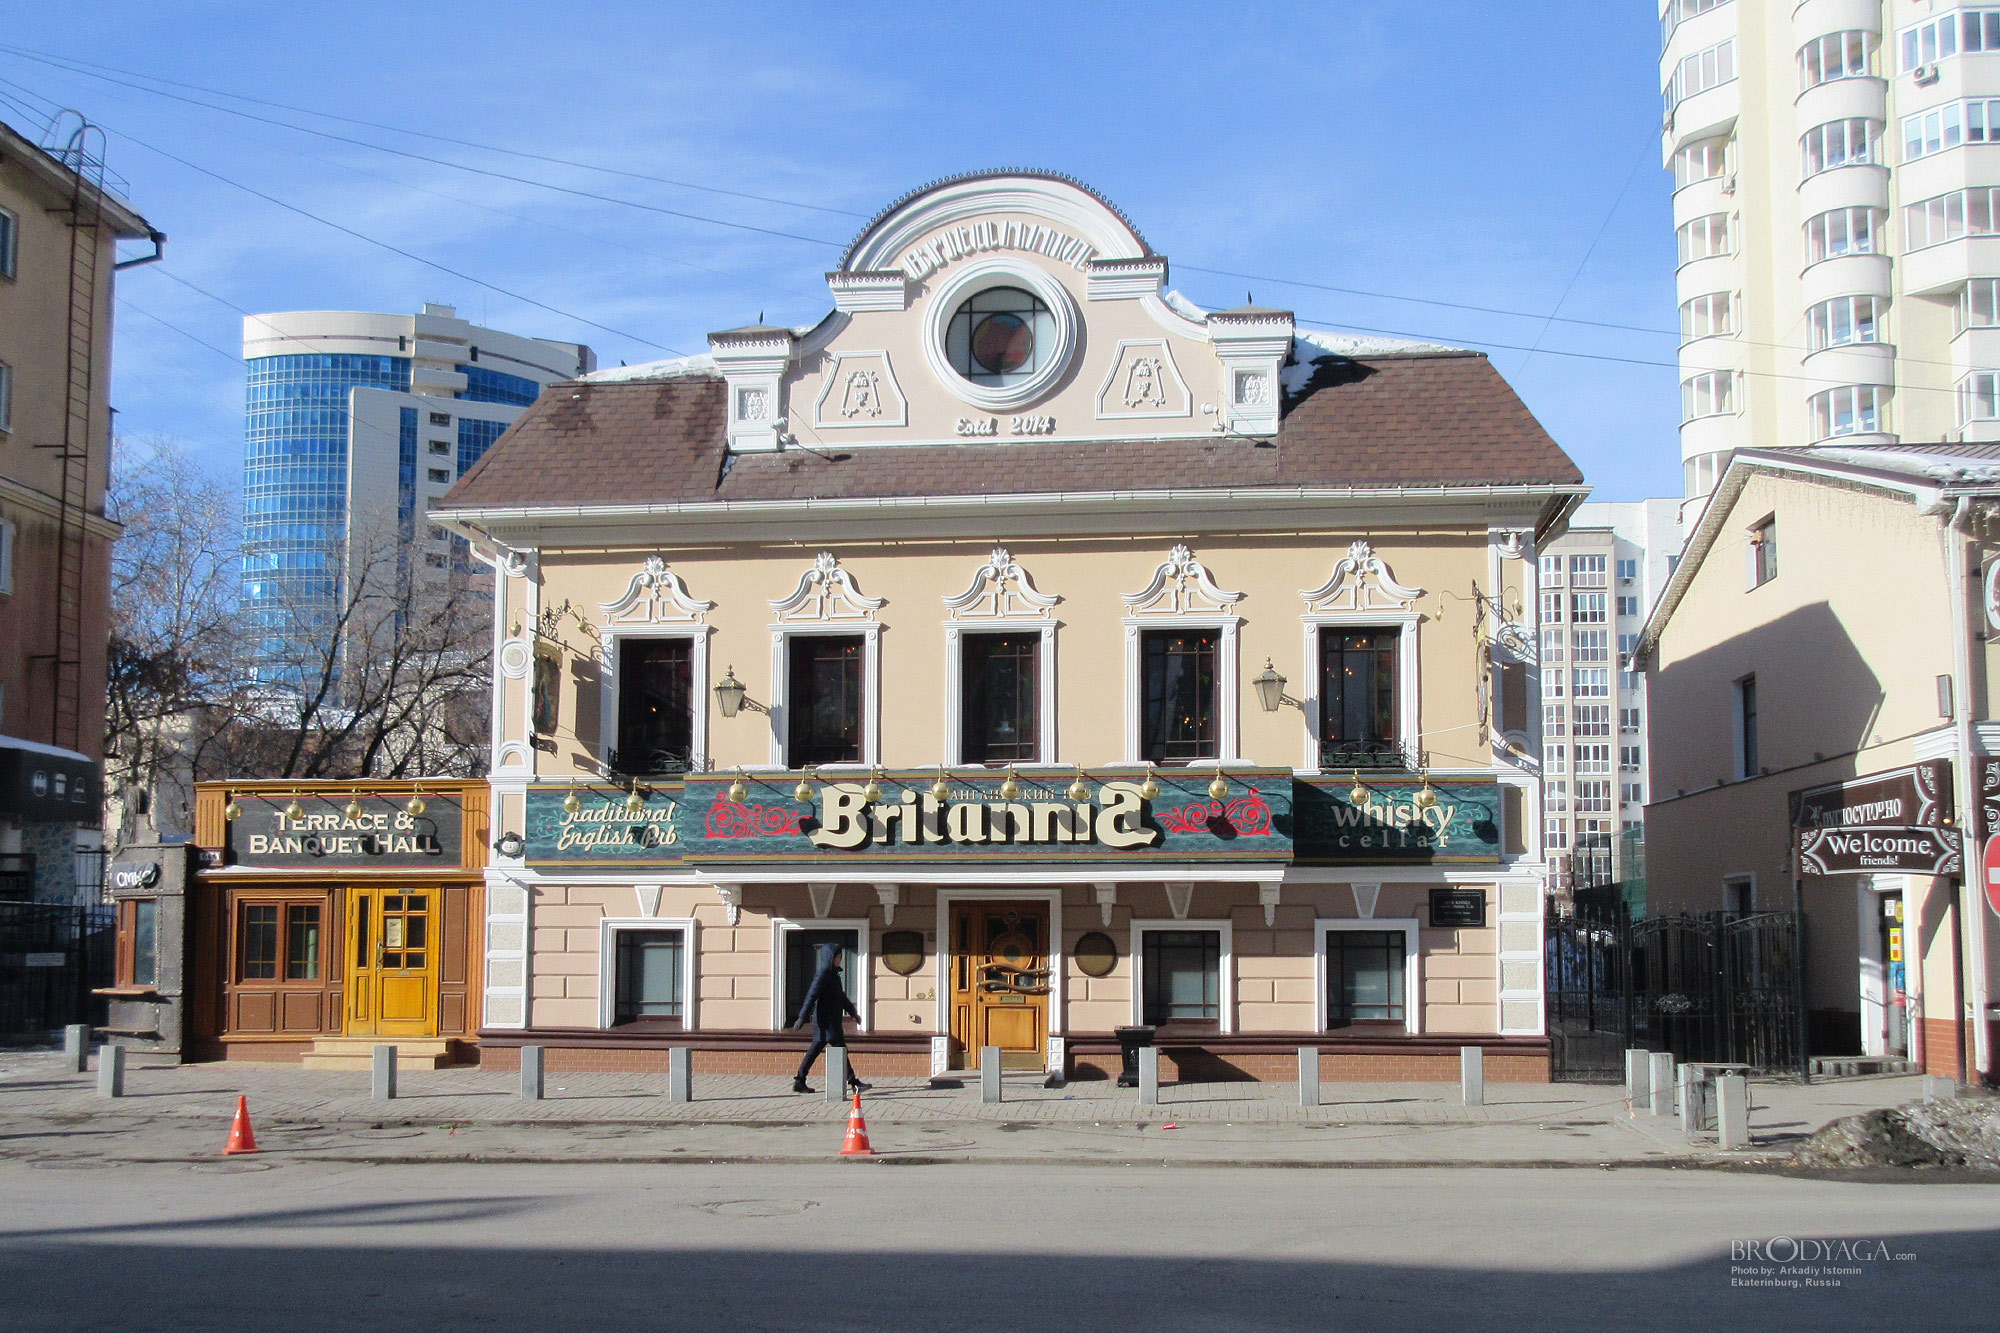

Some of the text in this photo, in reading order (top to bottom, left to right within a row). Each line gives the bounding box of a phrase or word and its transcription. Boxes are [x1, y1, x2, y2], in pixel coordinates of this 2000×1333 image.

[394, 811, 415, 831] &
[1330, 791, 1457, 842] whisky
[249, 833, 441, 855] BANQUET HALL
[557, 823, 678, 852] English Pub
[1338, 829, 1450, 849] cellar
[1826, 833, 1936, 858] Welcome,
[1859, 855, 1899, 866] friends!
